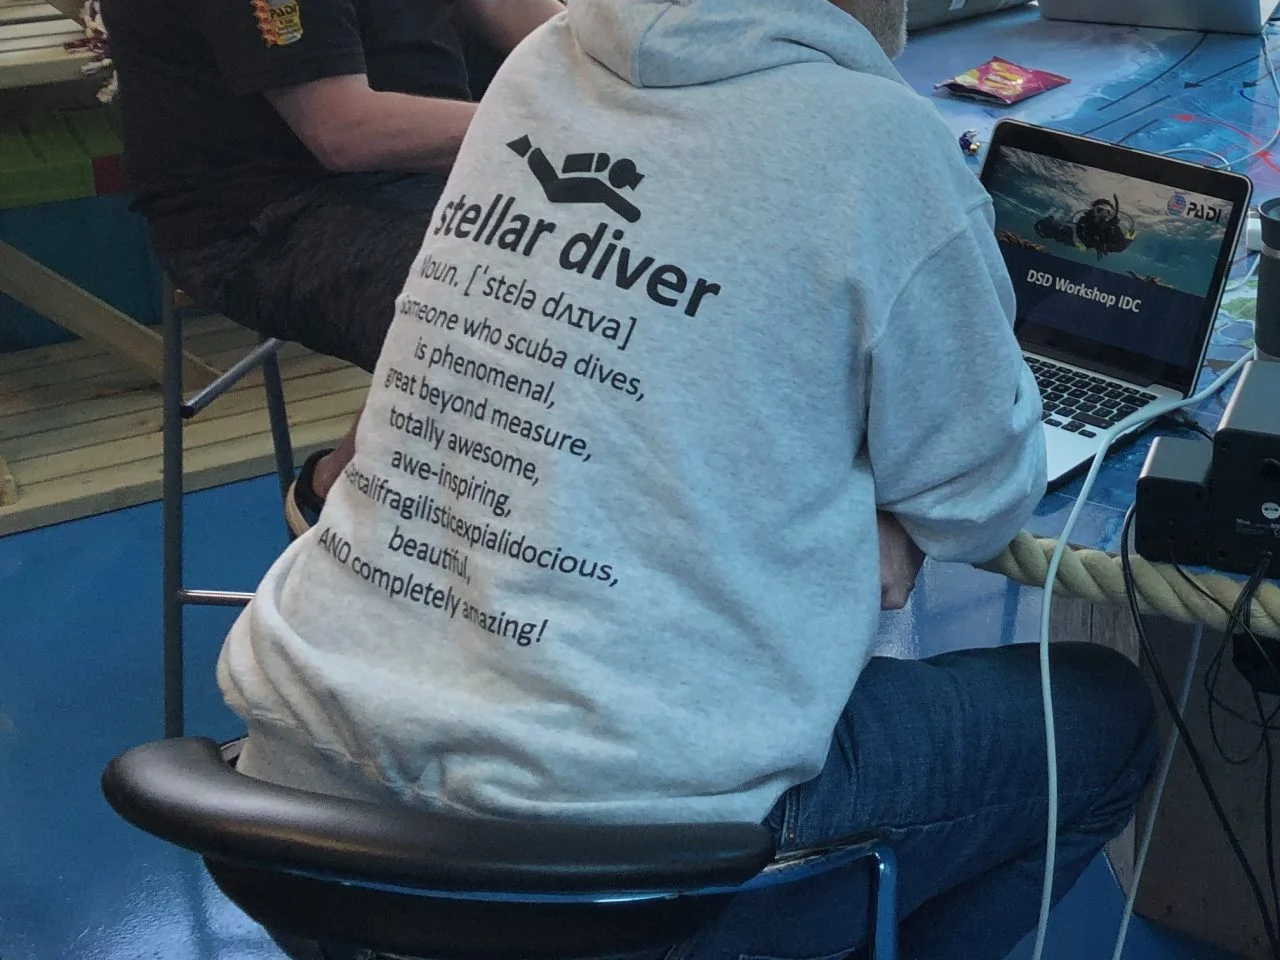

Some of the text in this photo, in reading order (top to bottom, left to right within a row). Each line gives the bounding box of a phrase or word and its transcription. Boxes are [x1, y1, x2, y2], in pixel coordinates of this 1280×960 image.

[433, 194, 557, 257] stellar
[1186, 201, 1222, 224] PADI
[558, 222, 722, 318] diver
[1026, 269, 1142, 313] DSD Workshop IDC
[413, 336, 556, 411] is phenomenal,
[463, 317, 502, 346] who
[504, 330, 568, 369] scuba
[573, 353, 645, 402] dives,
[384, 366, 593, 463] great beyond measure,
[389, 405, 541, 487] totally awesome,
[390, 448, 512, 519] awe-inspiring,
[318, 527, 550, 648] AND completely amazing!
[387, 524, 471, 586] beautiful,
